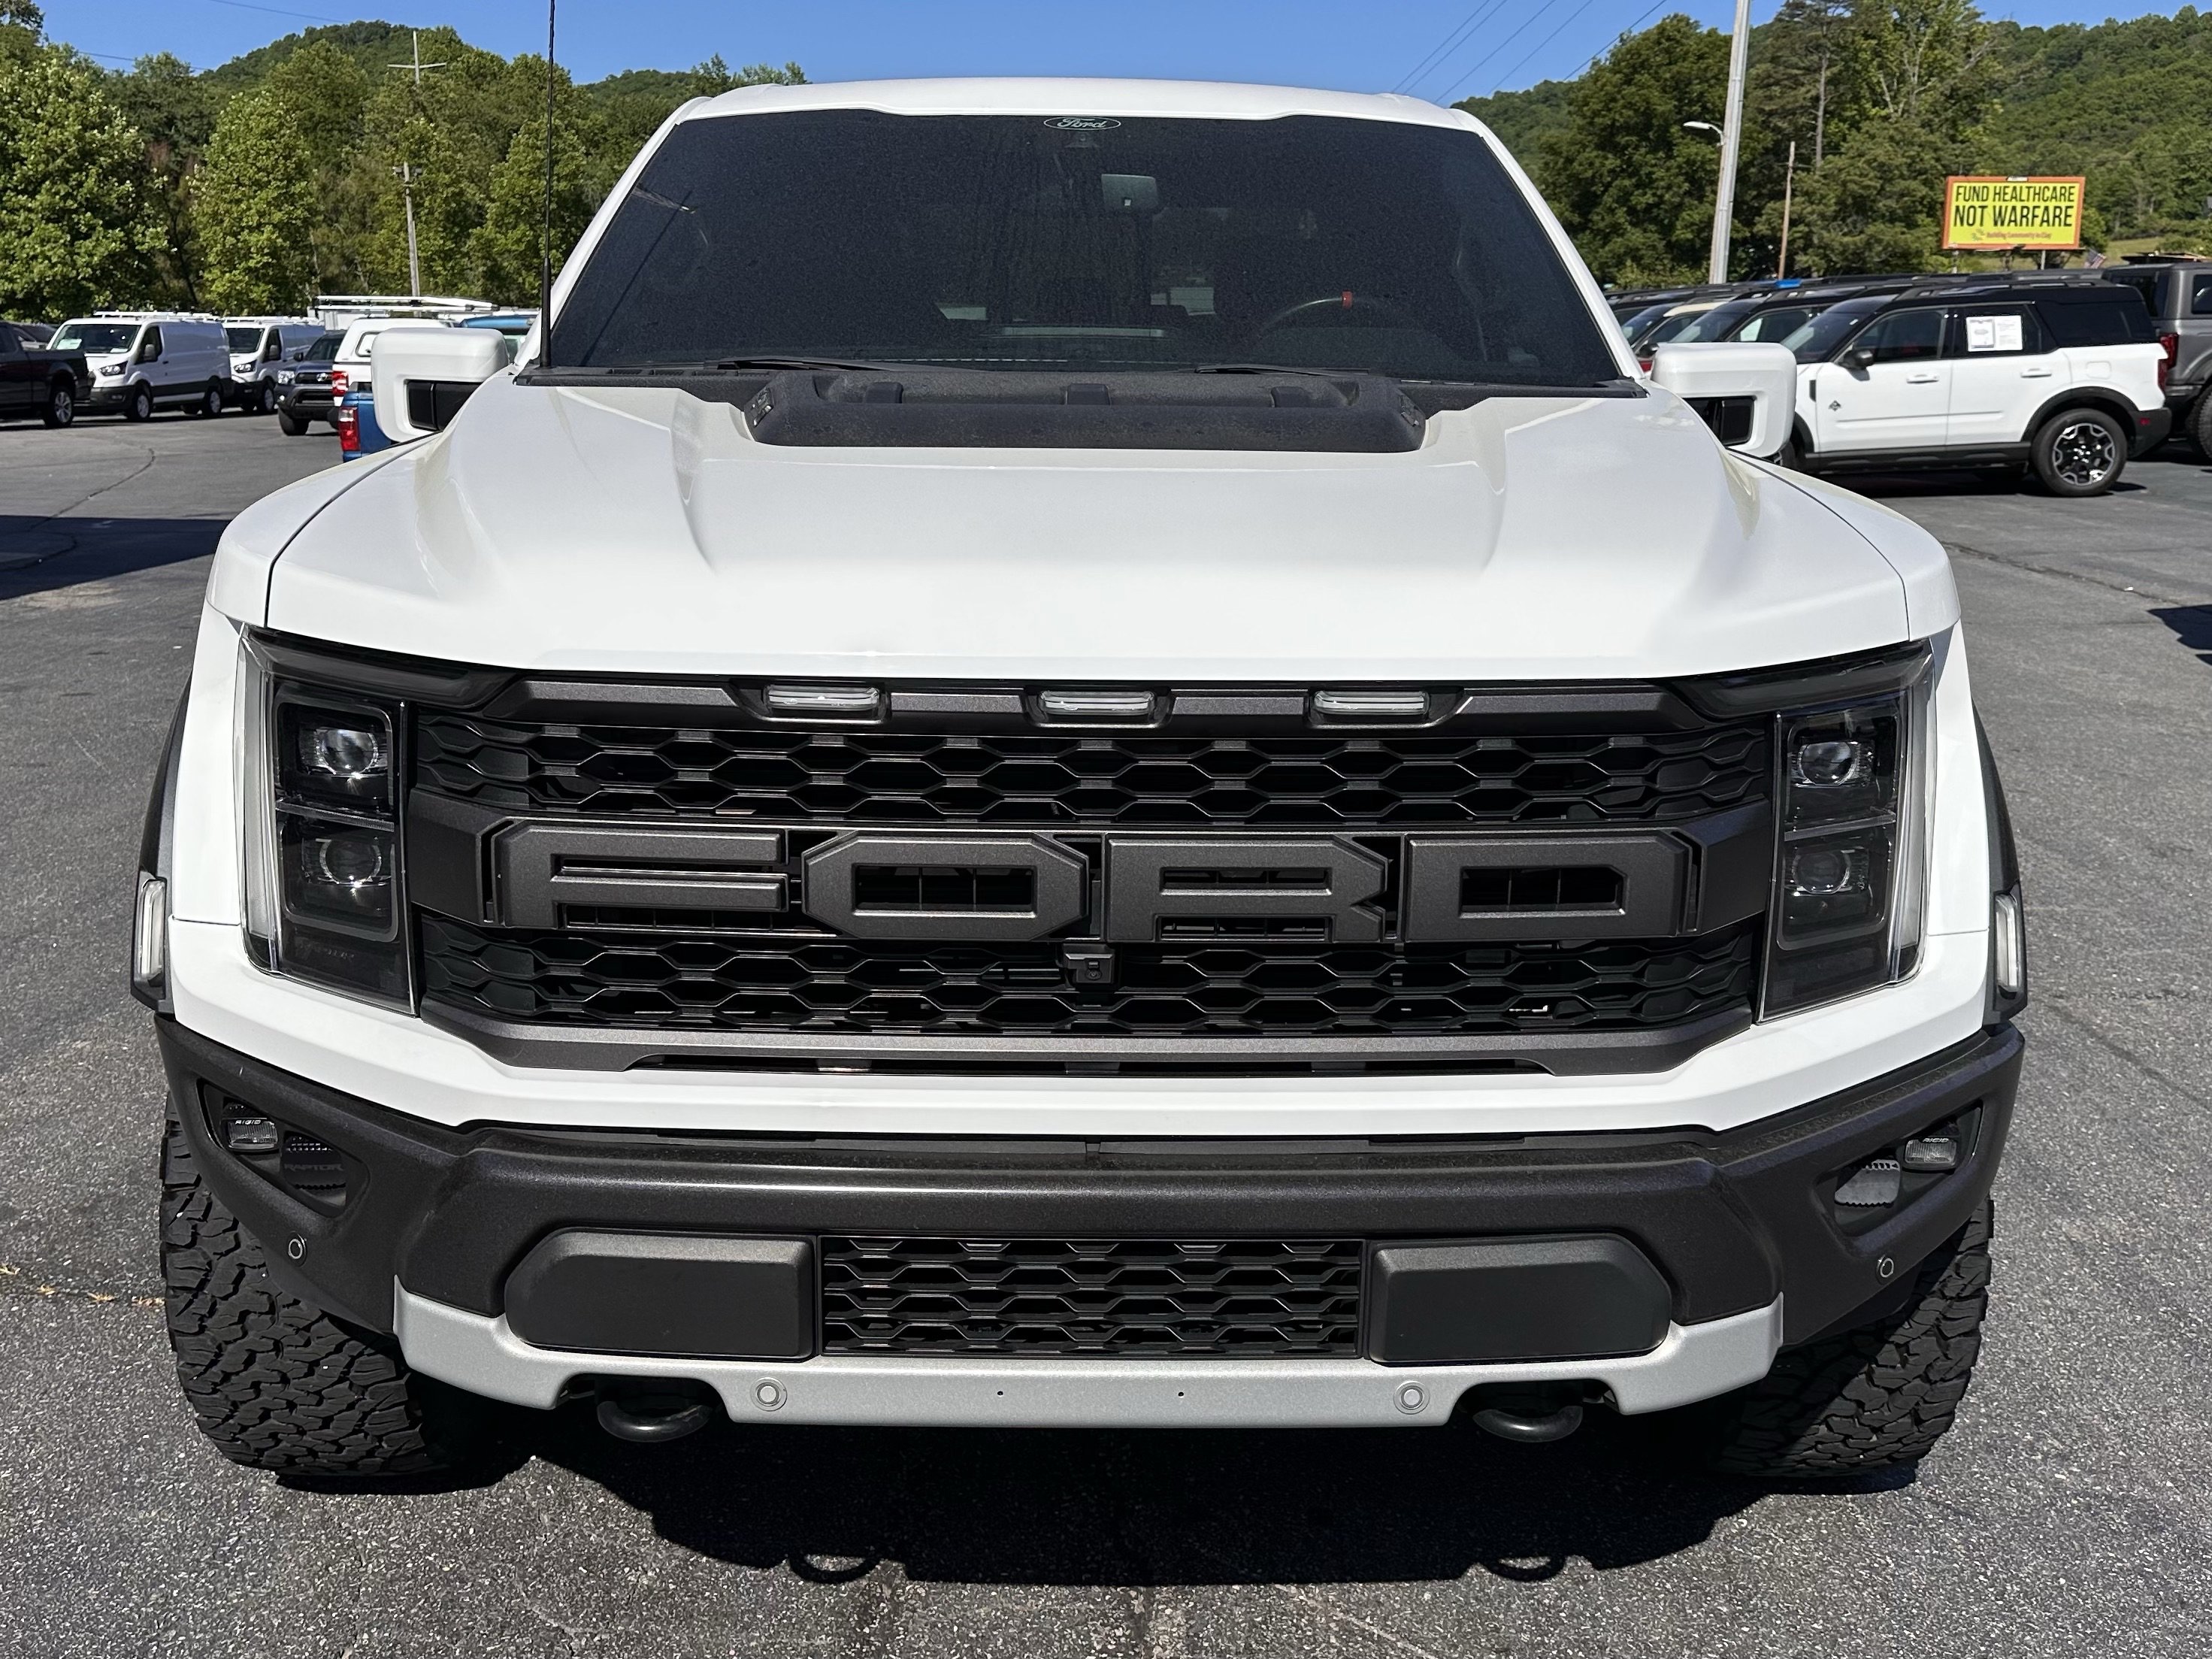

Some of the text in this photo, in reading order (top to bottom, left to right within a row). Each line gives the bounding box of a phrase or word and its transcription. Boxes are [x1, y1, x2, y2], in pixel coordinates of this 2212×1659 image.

[1057, 117, 1107, 128] Ford
[1955, 185, 2076, 202] FUND HEALTHCARE
[1953, 205, 2074, 227] NOT WARFARE
[490, 822, 1691, 943] FORD
[283, 1163, 344, 1172] RAPTOR
